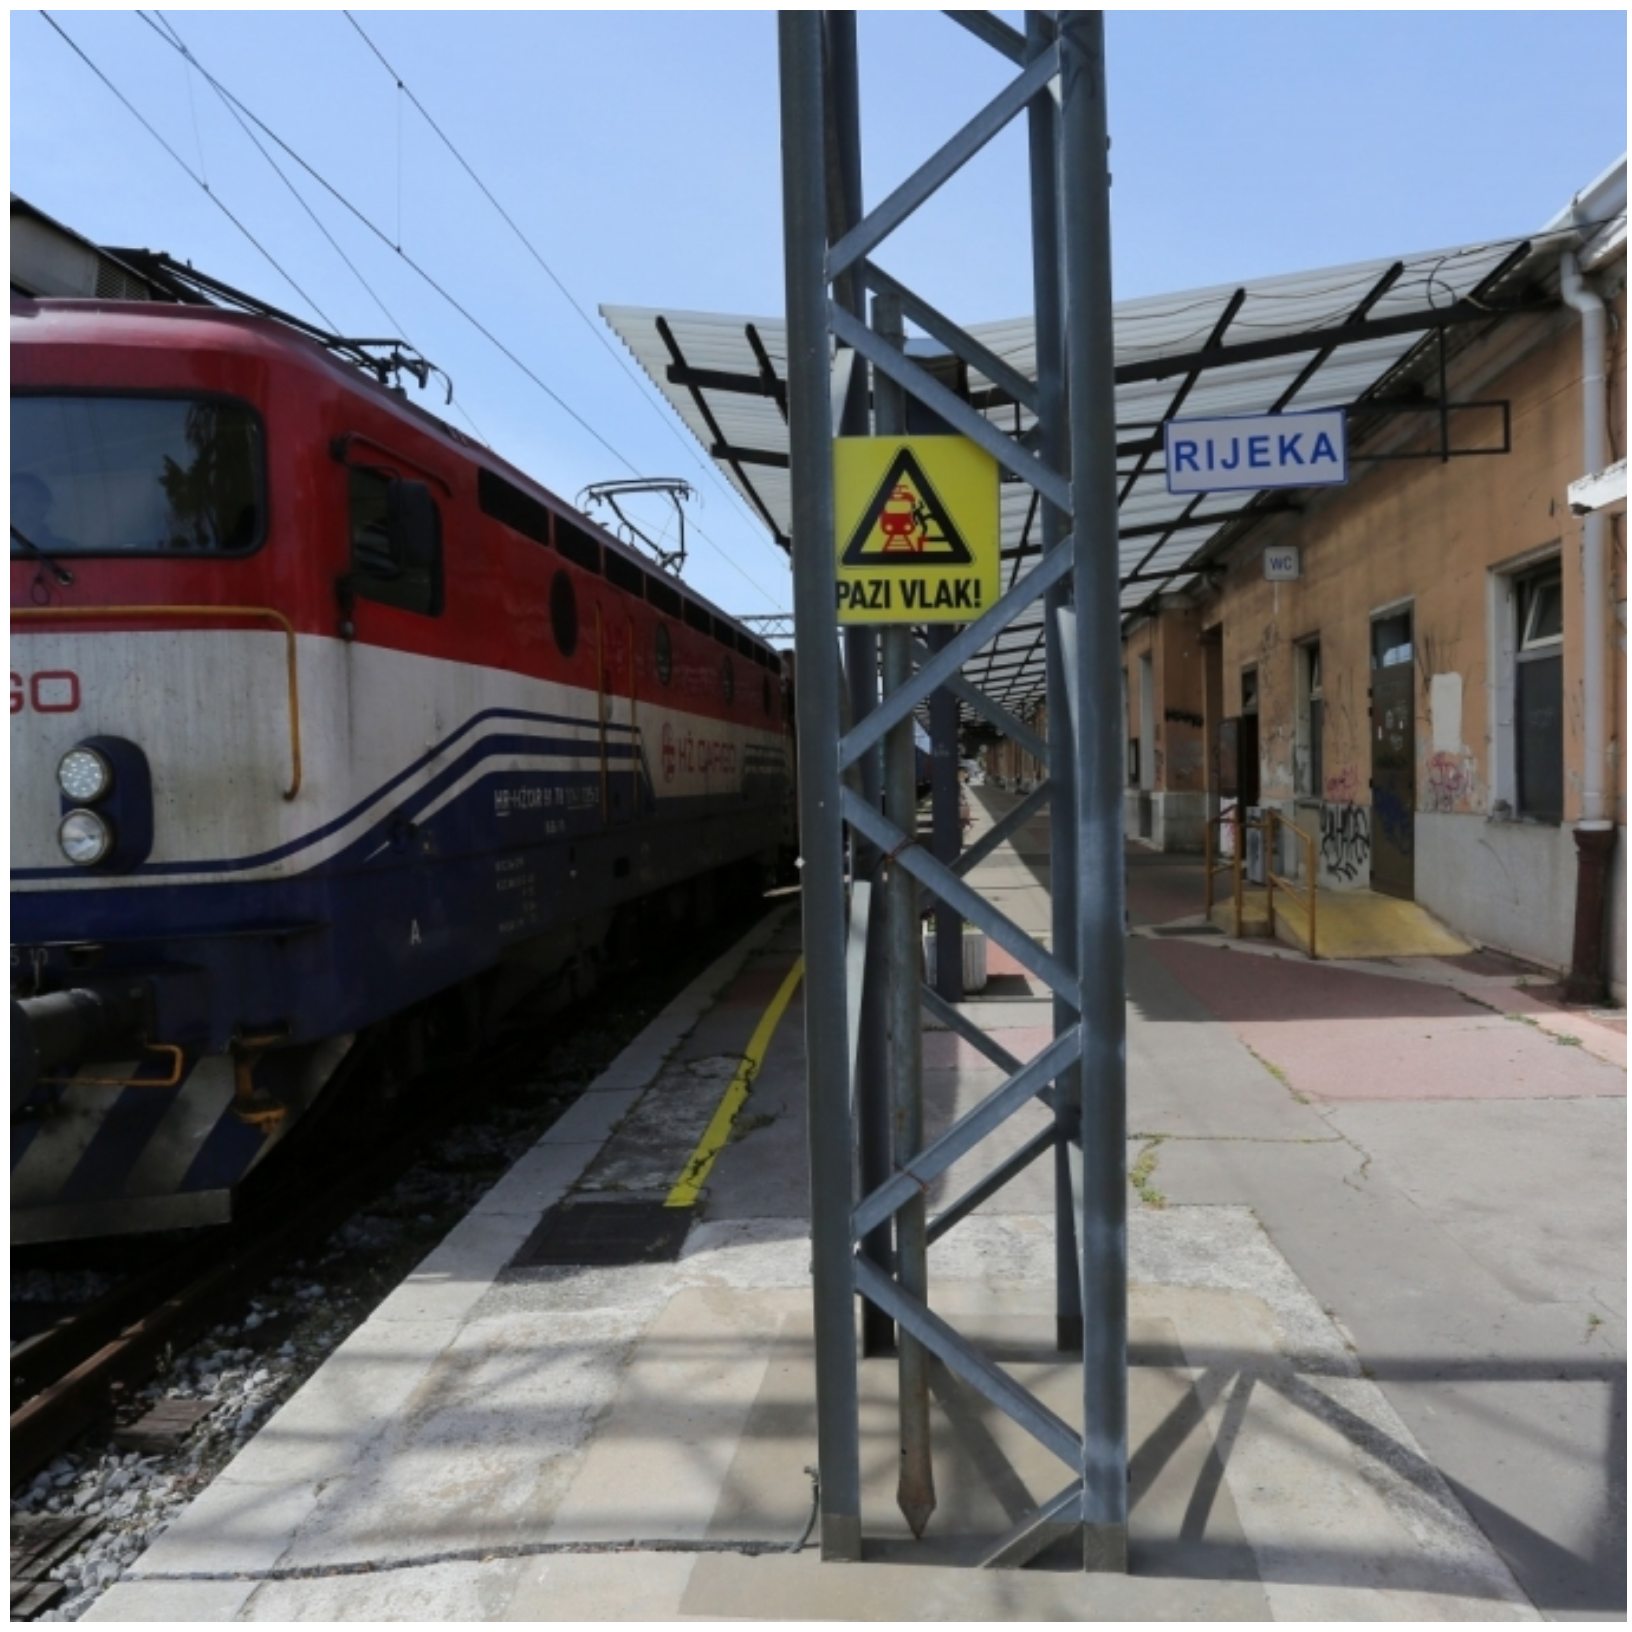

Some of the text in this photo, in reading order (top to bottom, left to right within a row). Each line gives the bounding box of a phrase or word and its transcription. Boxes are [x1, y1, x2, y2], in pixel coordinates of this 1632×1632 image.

[1174, 432, 1338, 472] RIJEKA
[1269, 556, 1292, 571] WC
[835, 578, 981, 609] PAZI VLAK!
[10, 671, 80, 713] O
[408, 918, 422, 945] A
